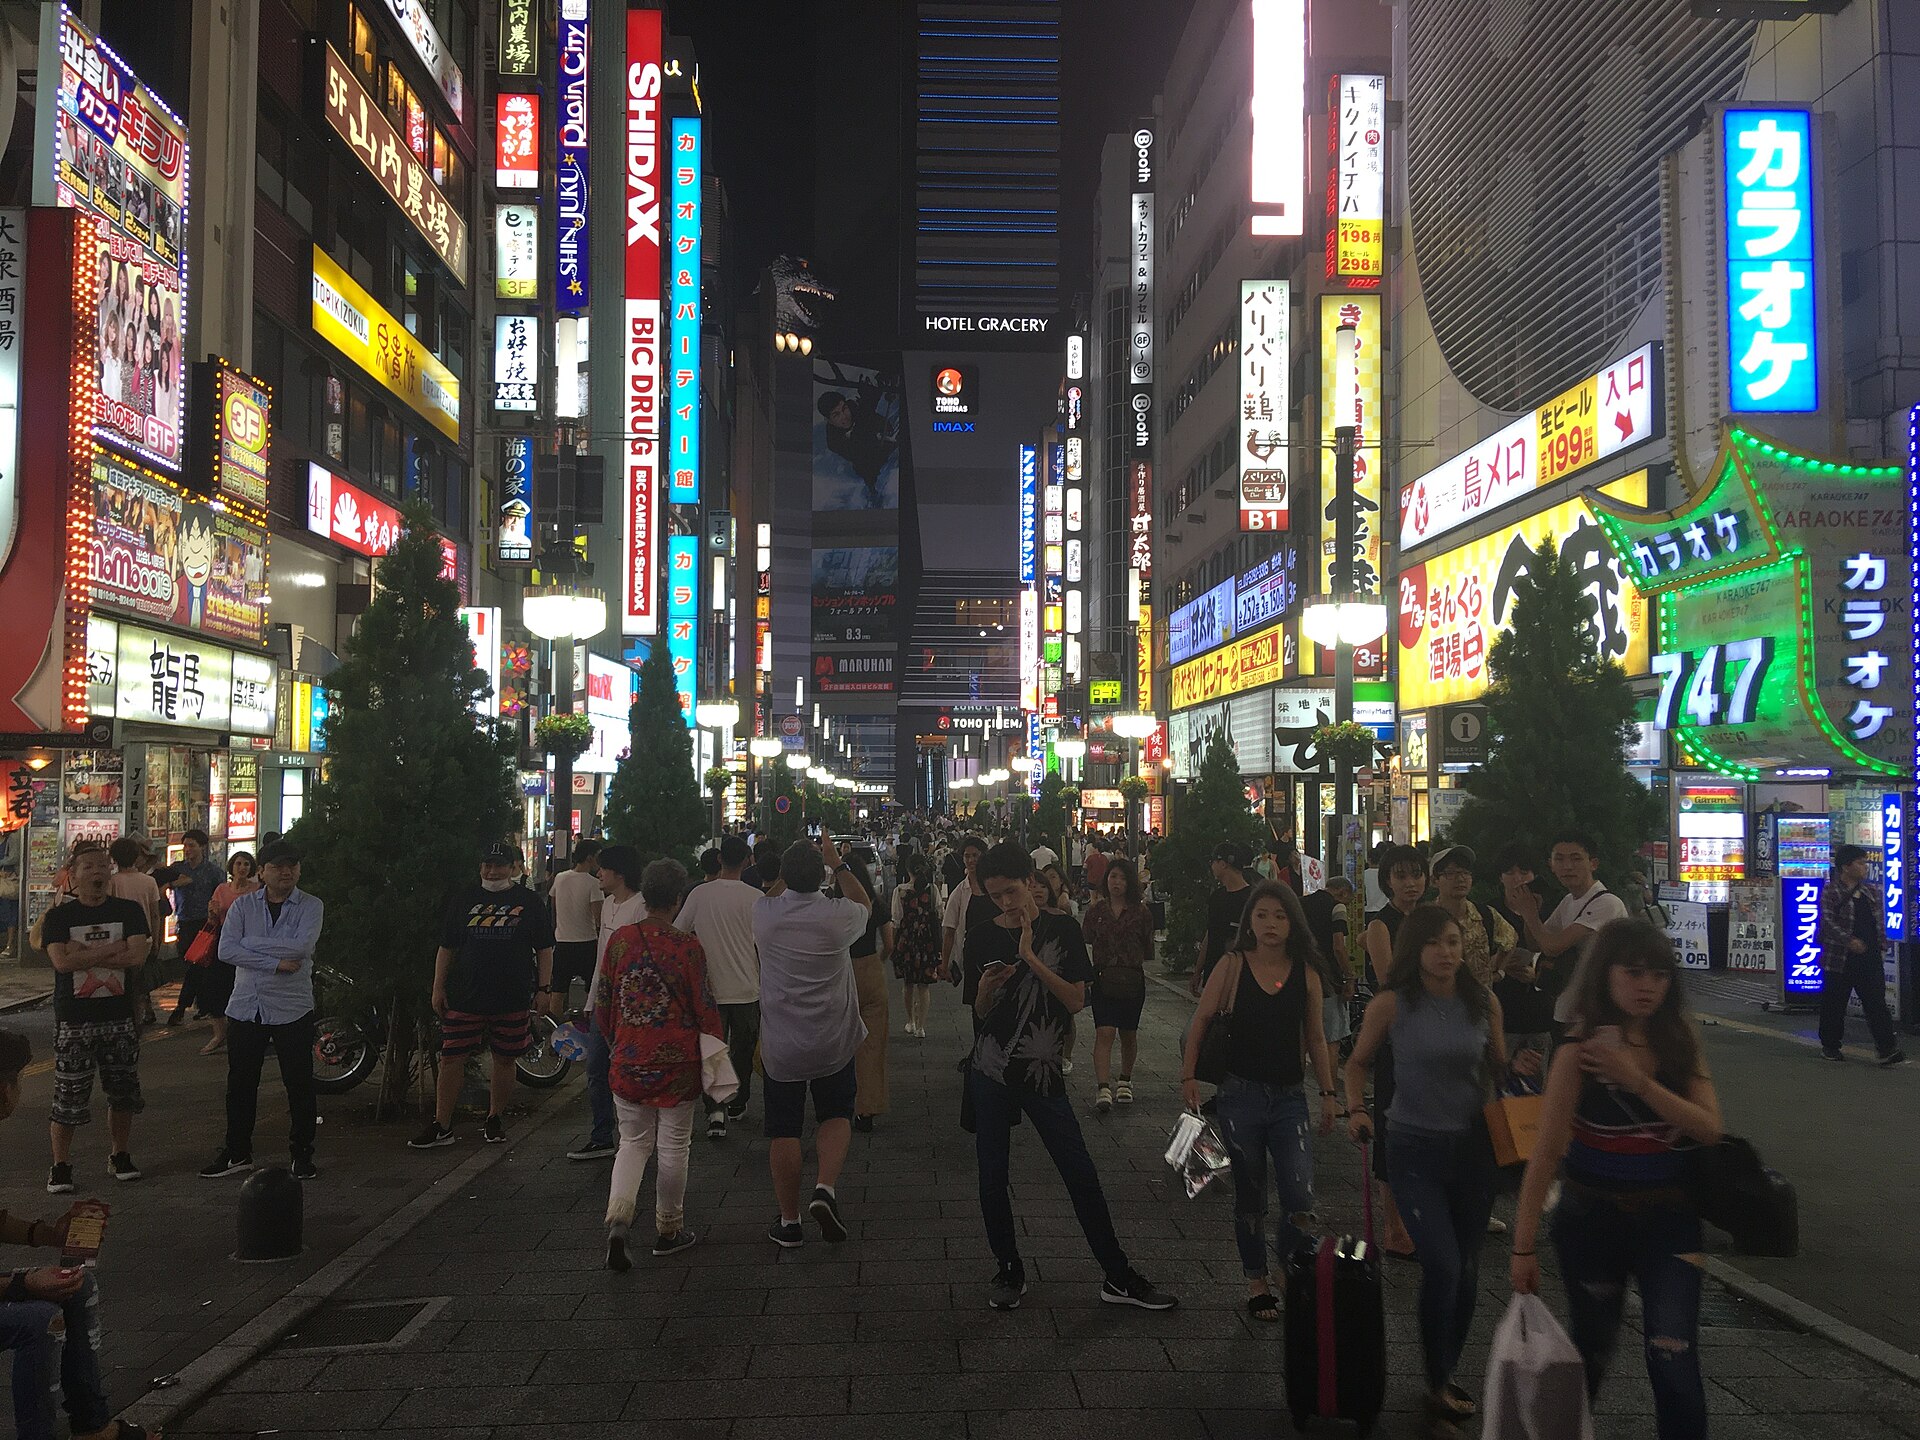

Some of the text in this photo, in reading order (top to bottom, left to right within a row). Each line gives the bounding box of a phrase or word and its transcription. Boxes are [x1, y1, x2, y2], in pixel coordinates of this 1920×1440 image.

[64, 25, 119, 104] 出会い
[512, 63, 525, 73] 5F
[1369, 79, 1383, 89] 4F
[79, 88, 118, 139] カフェ
[119, 92, 183, 181] キラリ
[329, 66, 450, 257] 5F 山内農場
[628, 62, 661, 246] SHIDAX
[1134, 129, 1153, 183] Booth
[1343, 87, 1361, 212] キクノイチバ
[559, 168, 580, 276] SHINJUKU
[1736, 119, 1808, 401] カラオケ
[507, 281, 527, 294] 3F
[676, 134, 695, 487] カラオケ&パーティー館
[507, 318, 528, 381] お好み焼
[926, 317, 1048, 332] HOTEL GRACERY
[1244, 286, 1275, 422] バリバリ鶏
[1606, 355, 1644, 406] 入口
[630, 318, 654, 456] BIC DRUG
[936, 397, 959, 406] TOHO
[1540, 386, 1592, 439] 生ビール
[231, 401, 260, 443] 3F
[933, 422, 975, 432] IMAX
[1133, 393, 1151, 446] Booth
[505, 438, 526, 495] 海の家
[635, 470, 647, 491] BIC
[1462, 437, 1525, 512] 鳥メロ
[309, 479, 328, 520] 4F
[634, 493, 647, 549] CAMERA
[1249, 511, 1277, 530] B1
[1401, 490, 1412, 508] 6F
[1131, 513, 1151, 572] 甘太郎
[1632, 512, 1738, 578] カラオケ
[634, 556, 645, 611] SHIDAX
[1429, 575, 1482, 629] きんくら
[1715, 581, 1771, 603] KARAOKE747
[830, 607, 879, 615] フォールアウト
[846, 628, 861, 640] 8.3
[839, 658, 892, 672] MARUHAN
[1284, 634, 1295, 665] 2F
[1430, 632, 1460, 682] 酒場
[1841, 553, 1893, 740] カラオケ
[150, 638, 204, 721] 龍馬
[1093, 689, 1118, 697] ロード
[1652, 637, 1763, 730] 747
[953, 718, 983, 729] TOHO
[1695, 796, 1727, 804] Garam
[1681, 843, 1687, 858] 6F
[1886, 804, 1902, 929] カラオケ 747
[1795, 883, 1821, 964] カラオケ
